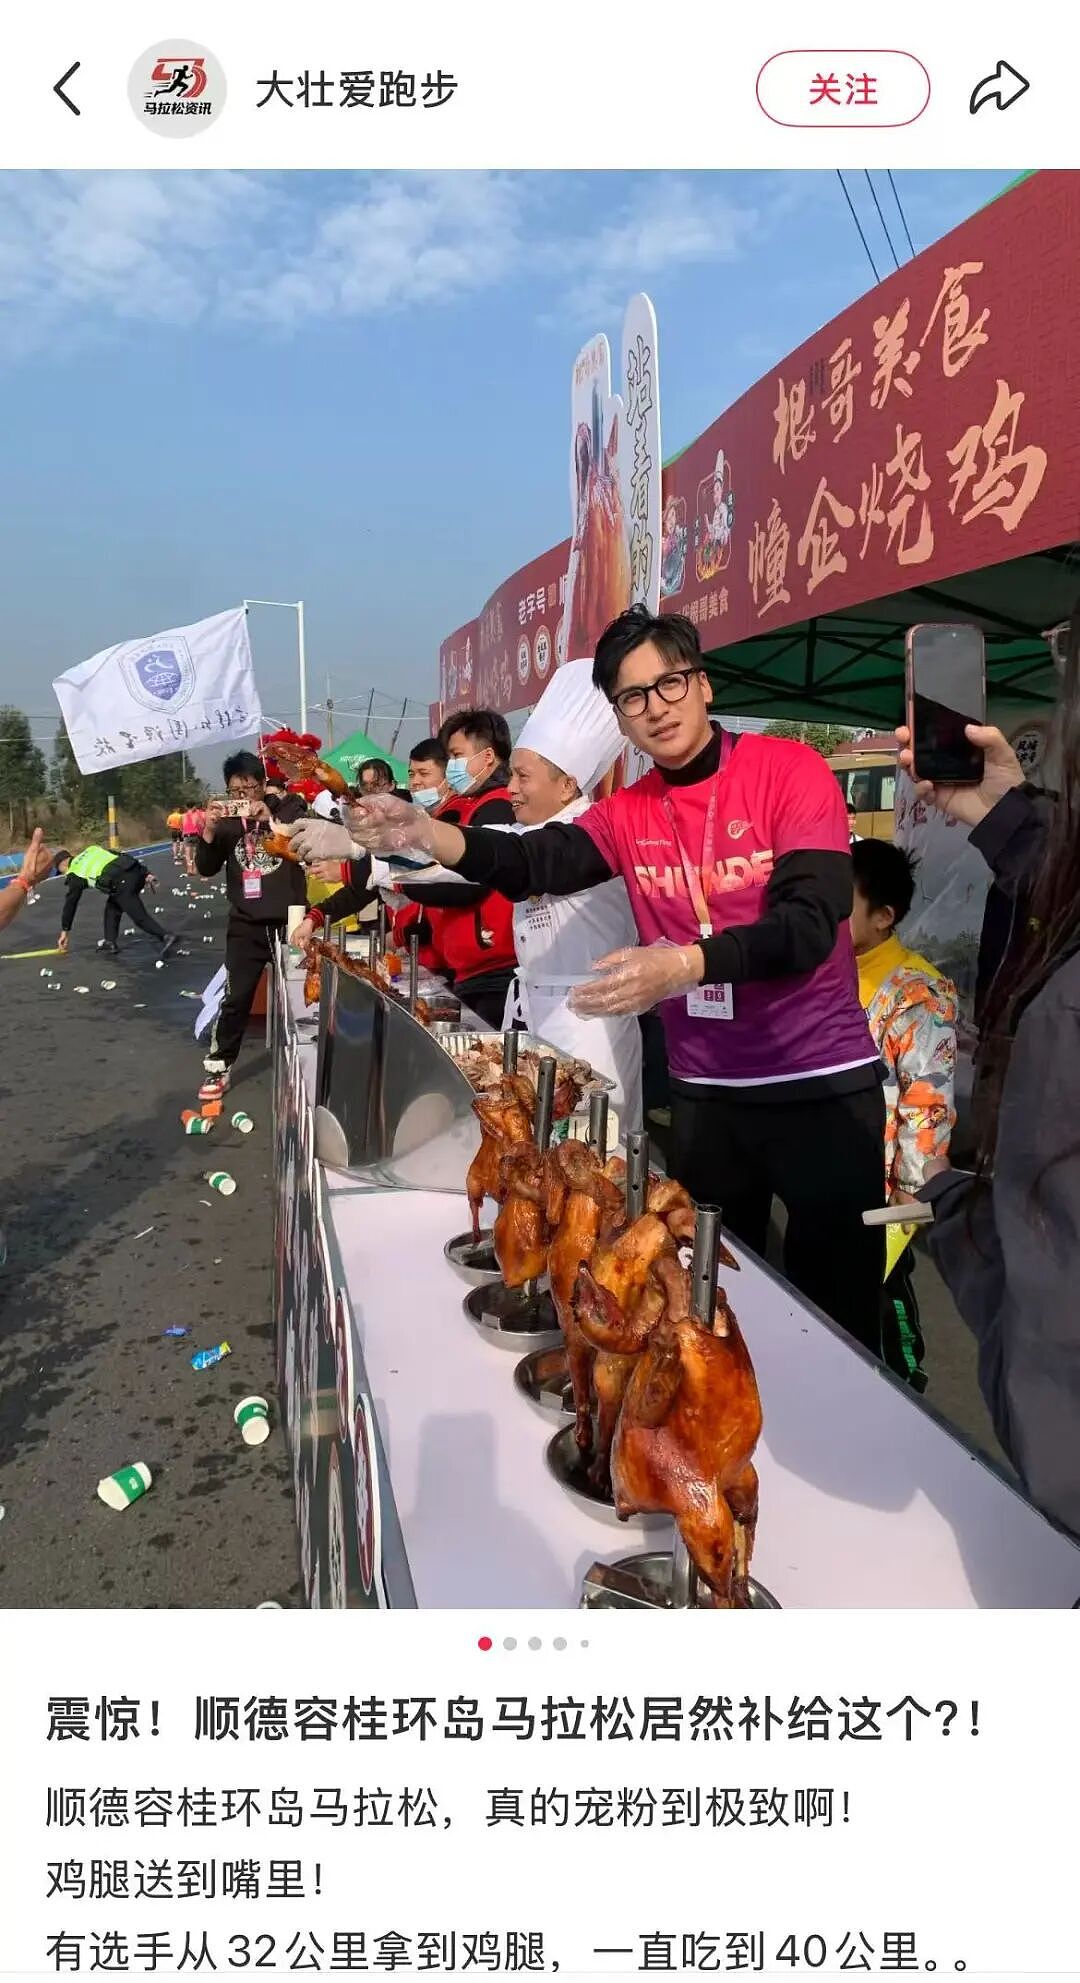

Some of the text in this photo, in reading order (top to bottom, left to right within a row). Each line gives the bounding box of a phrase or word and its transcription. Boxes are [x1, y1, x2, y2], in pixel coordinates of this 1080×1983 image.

[773, 262, 989, 474] 根哥美食
[518, 586, 546, 625] 老字号
